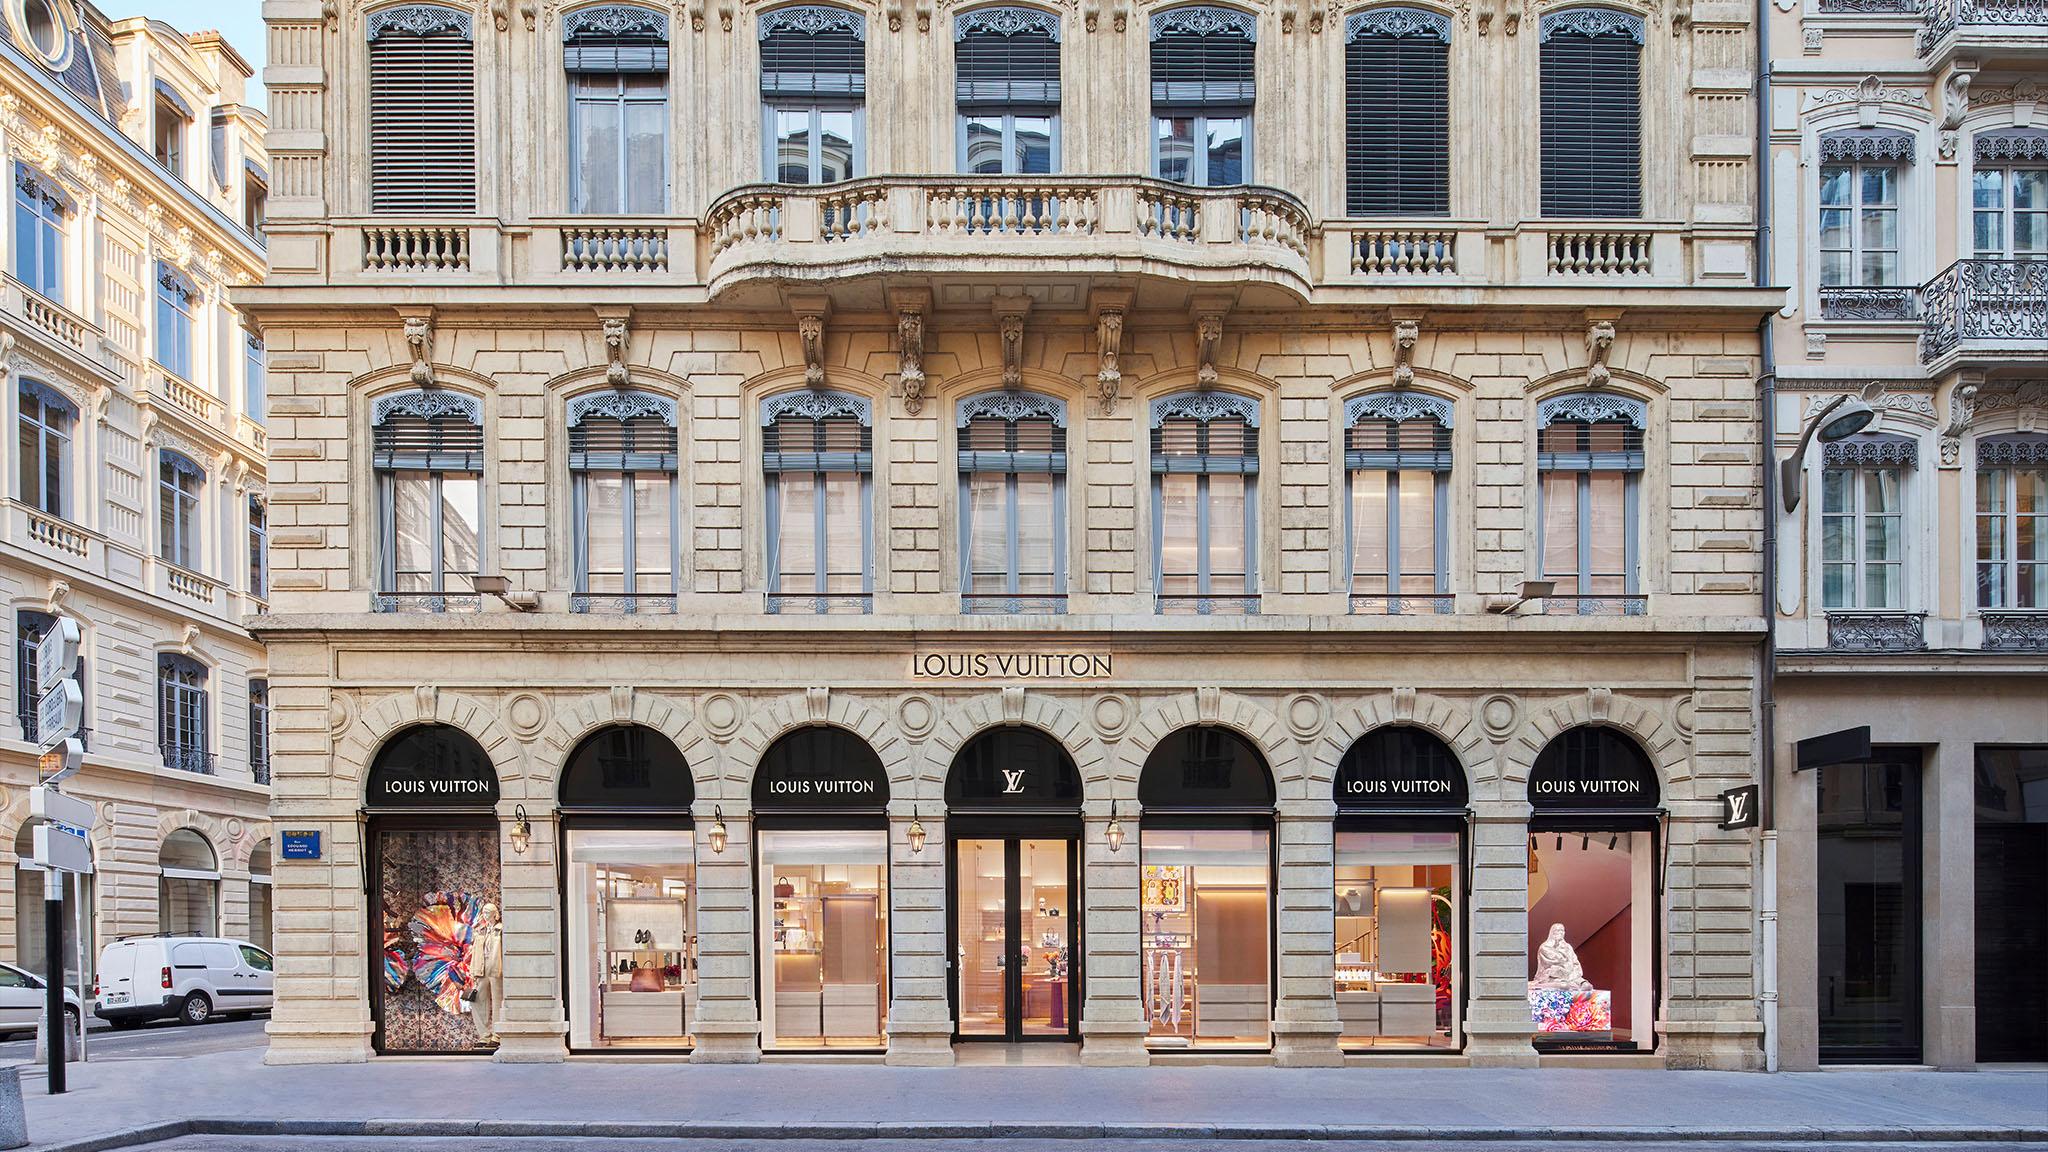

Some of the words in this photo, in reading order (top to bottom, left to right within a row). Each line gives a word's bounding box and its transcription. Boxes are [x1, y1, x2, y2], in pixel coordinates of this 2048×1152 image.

[914, 653, 989, 676] LOUIS
[996, 654, 1112, 676] VUITTON
[385, 780, 425, 793] LOUIS
[430, 780, 489, 793] VUITTON
[770, 780, 810, 793] LOUIS
[815, 780, 874, 793] VUITTON
[1347, 780, 1387, 793] LOUIS
[1391, 780, 1451, 793] VUITTON
[1536, 780, 1576, 793] LOUIS
[1580, 780, 1639, 793] VUITTON
